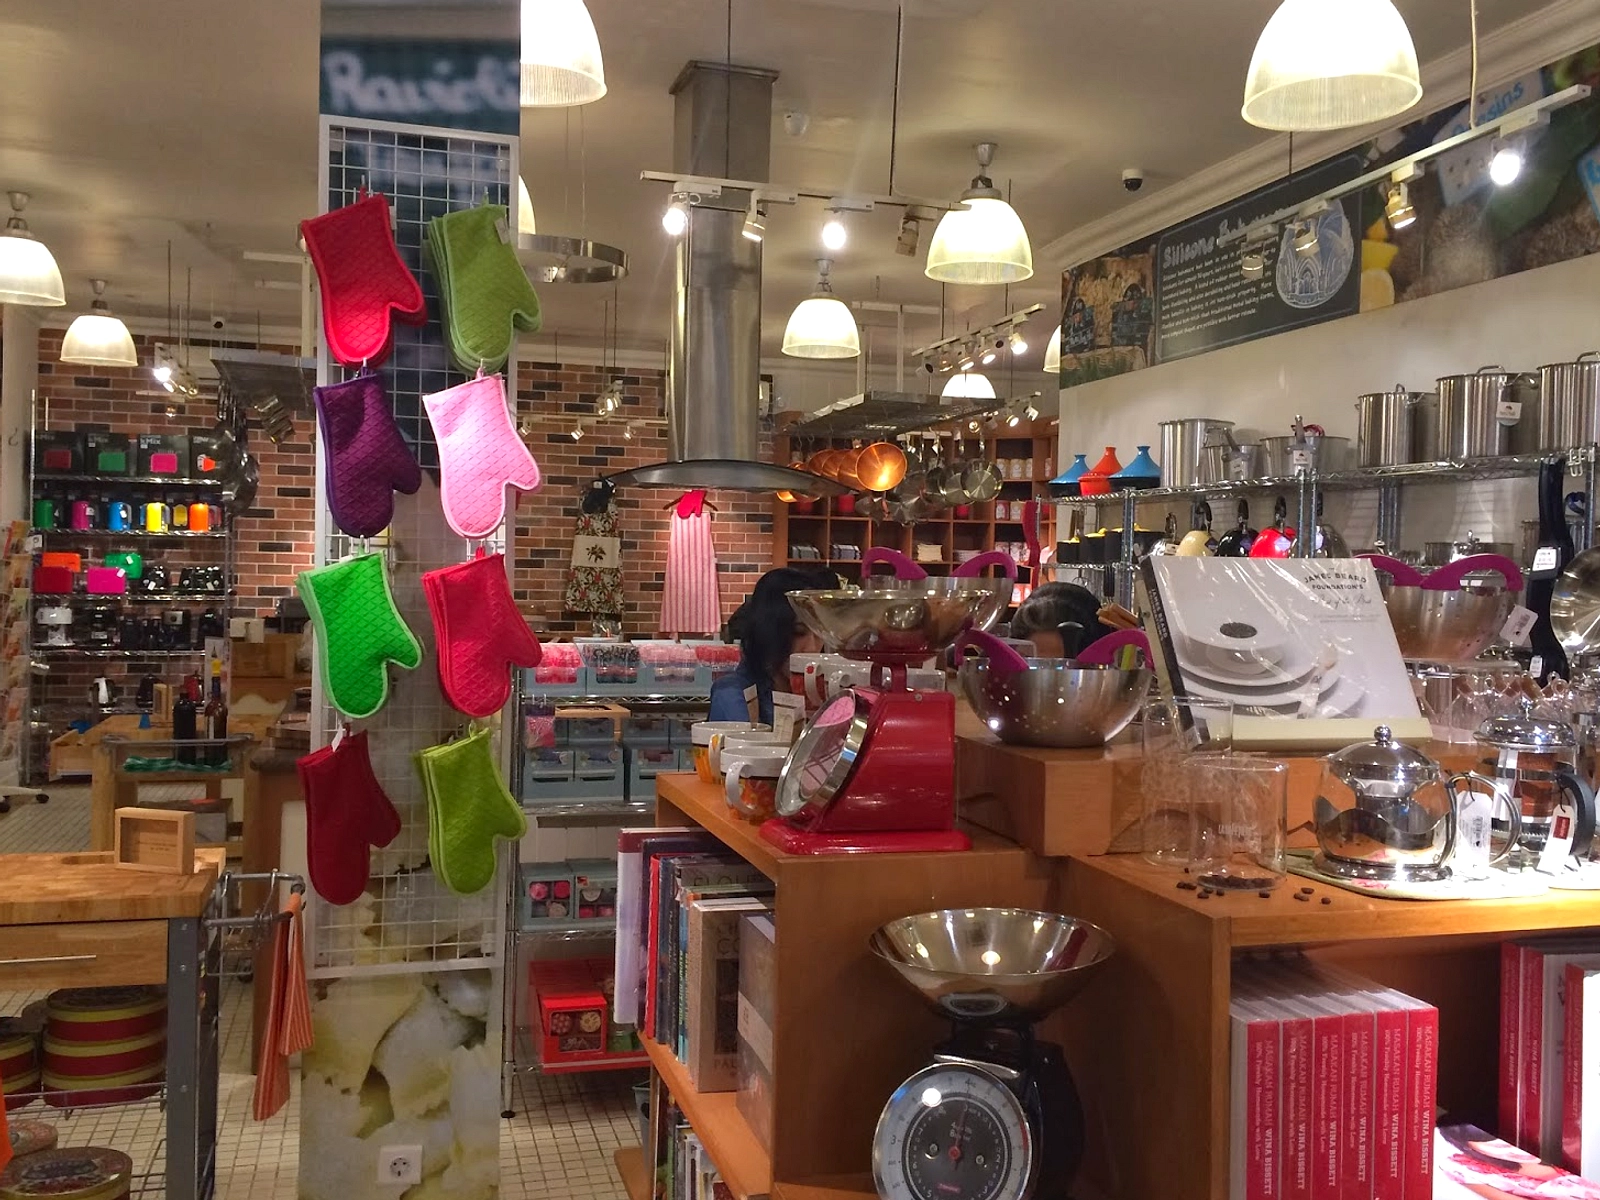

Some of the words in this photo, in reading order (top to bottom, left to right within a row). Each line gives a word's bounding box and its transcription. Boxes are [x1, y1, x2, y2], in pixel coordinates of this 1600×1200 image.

[1163, 236, 1215, 269] Silicone
[1422, 1110, 1430, 1136] WINA
[1390, 1141, 1398, 1178] BISSETT
